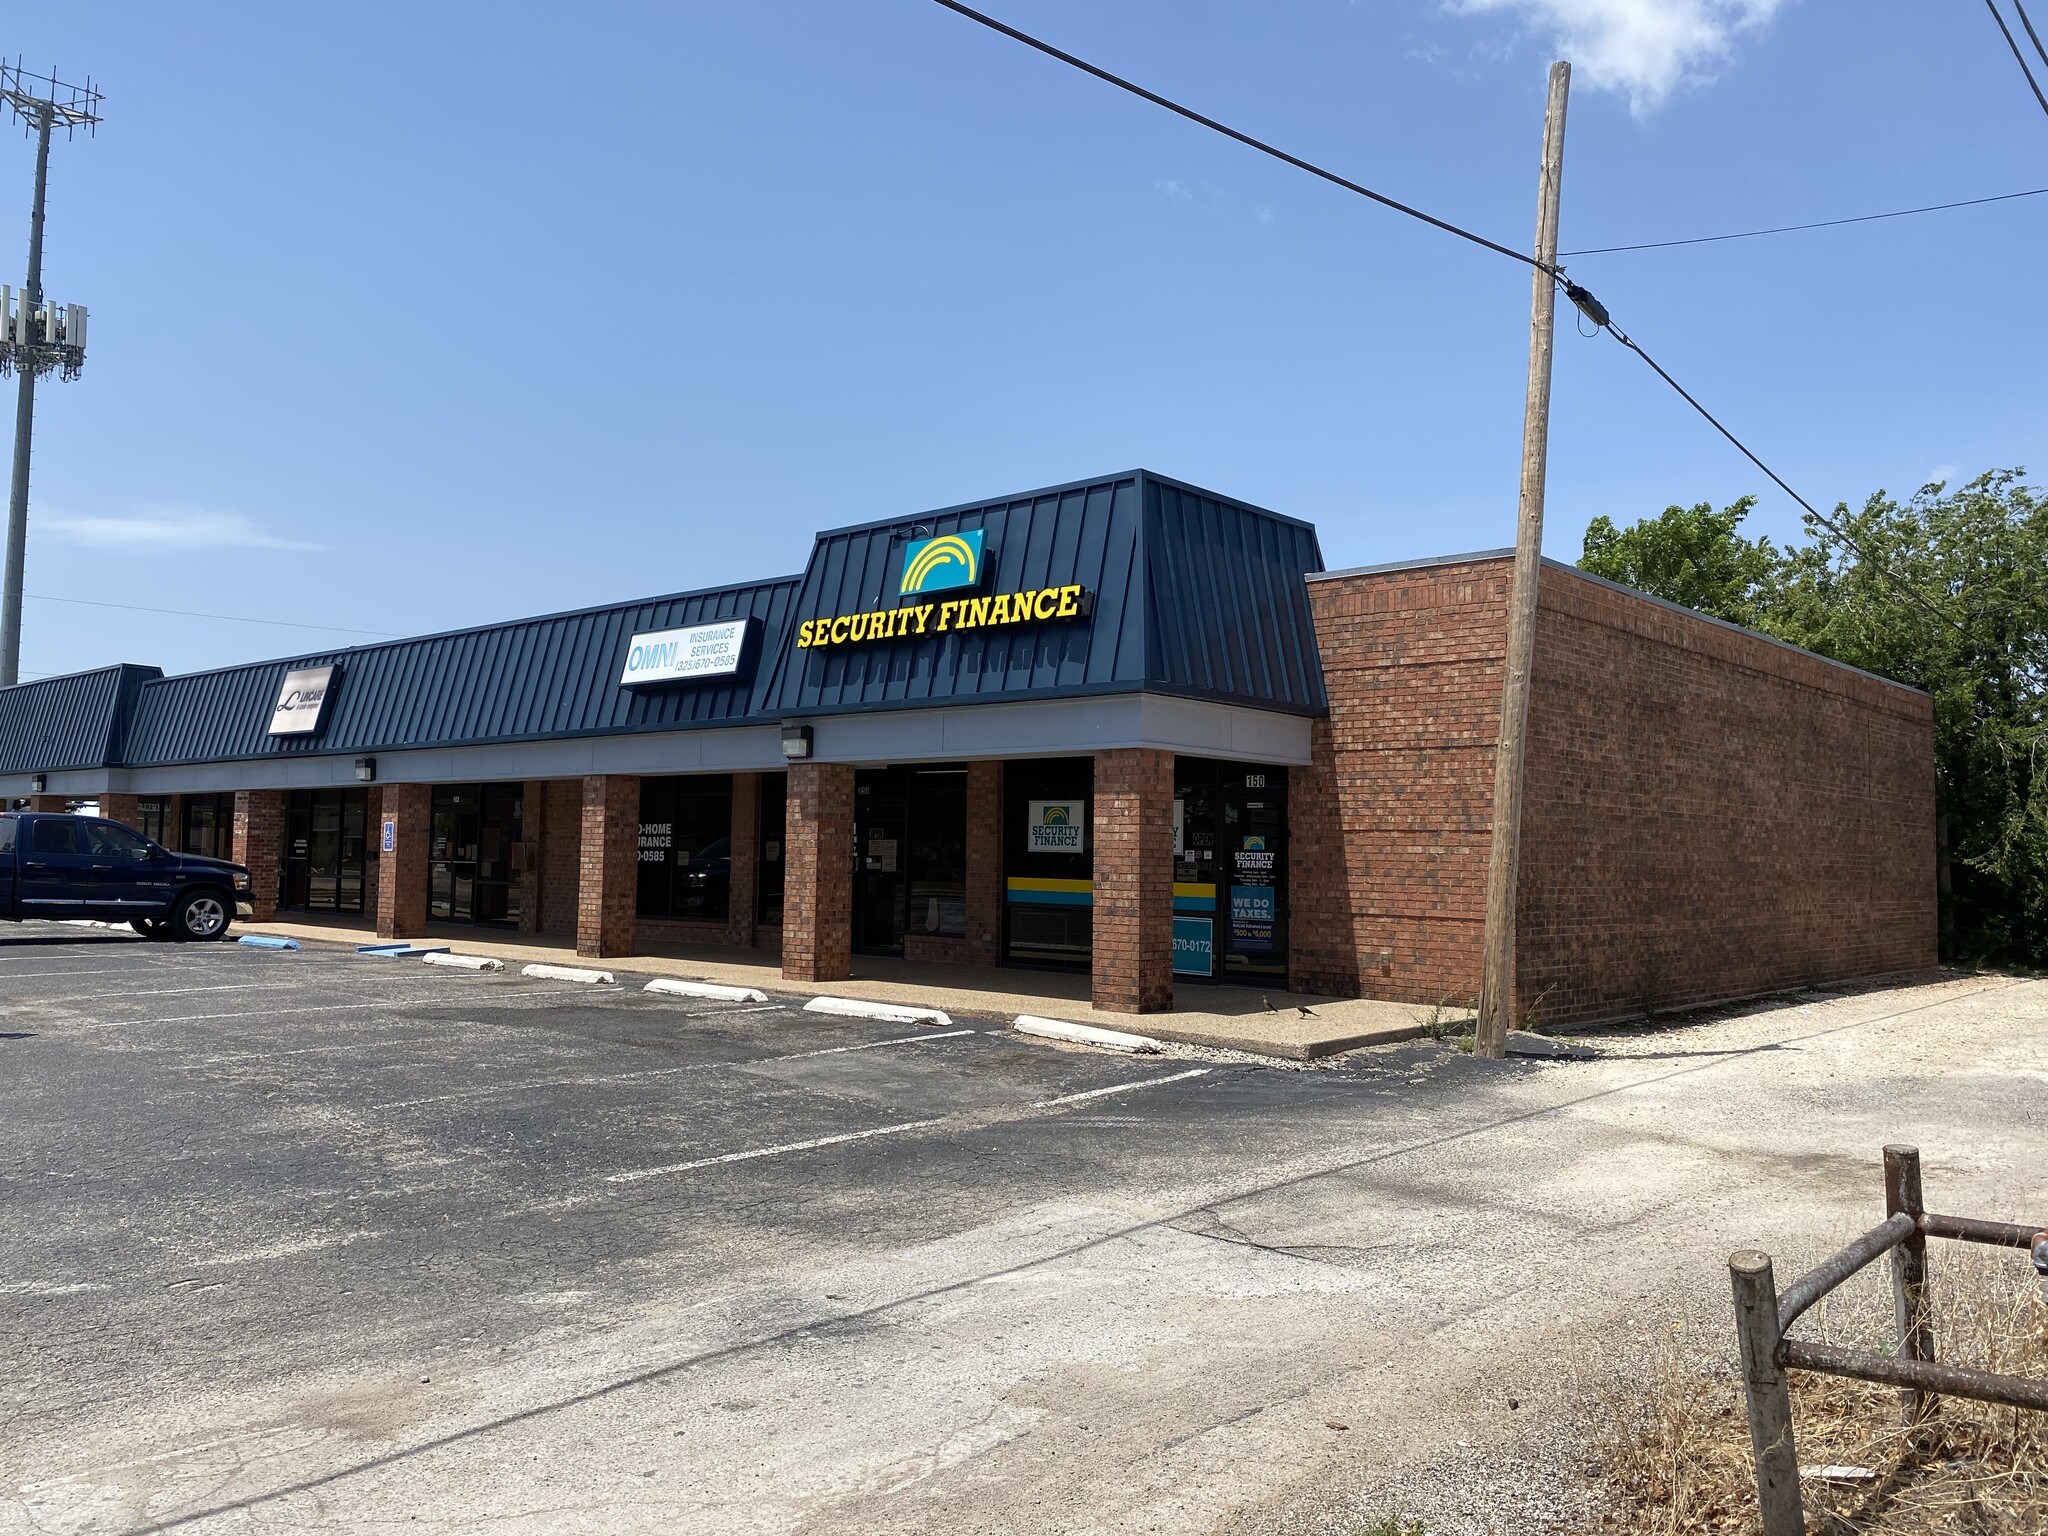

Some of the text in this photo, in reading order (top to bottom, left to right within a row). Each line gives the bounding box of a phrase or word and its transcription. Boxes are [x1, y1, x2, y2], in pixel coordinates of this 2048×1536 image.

[797, 585, 1081, 648] SECURITY FINANCE
[690, 627, 735, 644] INSURANCE
[691, 642, 729, 658] SERVICES
[628, 641, 679, 671] OMNI
[675, 655, 736, 672] (325)670-0585
[1247, 775, 1264, 787] 150
[1032, 825, 1080, 836] SECURITY
[1034, 836, 1077, 846] FINANCE
[1193, 833, 1213, 844] OPEN
[1234, 852, 1275, 861] SECURITY
[1236, 860, 1273, 868] FINANCE
[1233, 898, 1269, 908] WE DO
[1233, 908, 1271, 919] TAXES.
[1172, 938, 1211, 953] 670-0172
